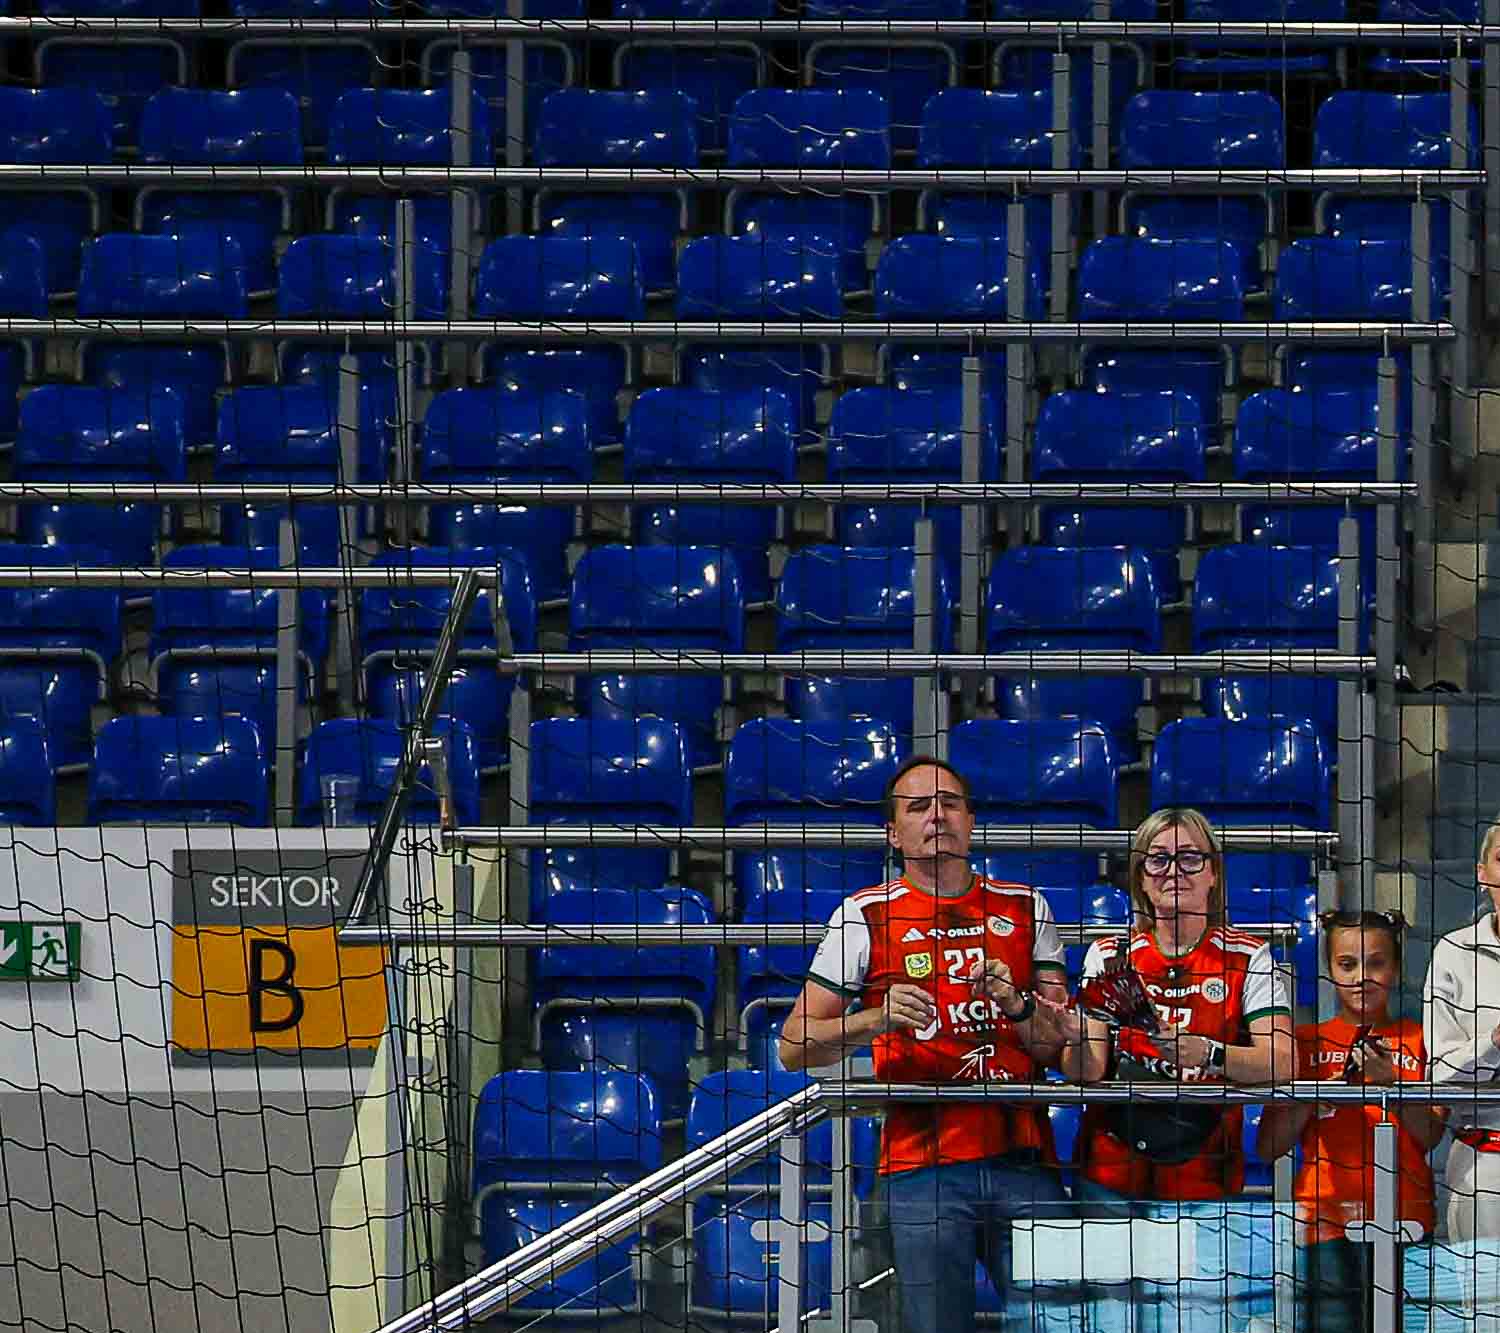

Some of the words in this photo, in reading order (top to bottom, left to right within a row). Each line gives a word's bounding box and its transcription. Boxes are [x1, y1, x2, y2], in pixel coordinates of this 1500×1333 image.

[210, 876, 342, 909] SEKTOR
[248, 938, 304, 1033] B
[948, 1000, 1001, 1024] KGH
